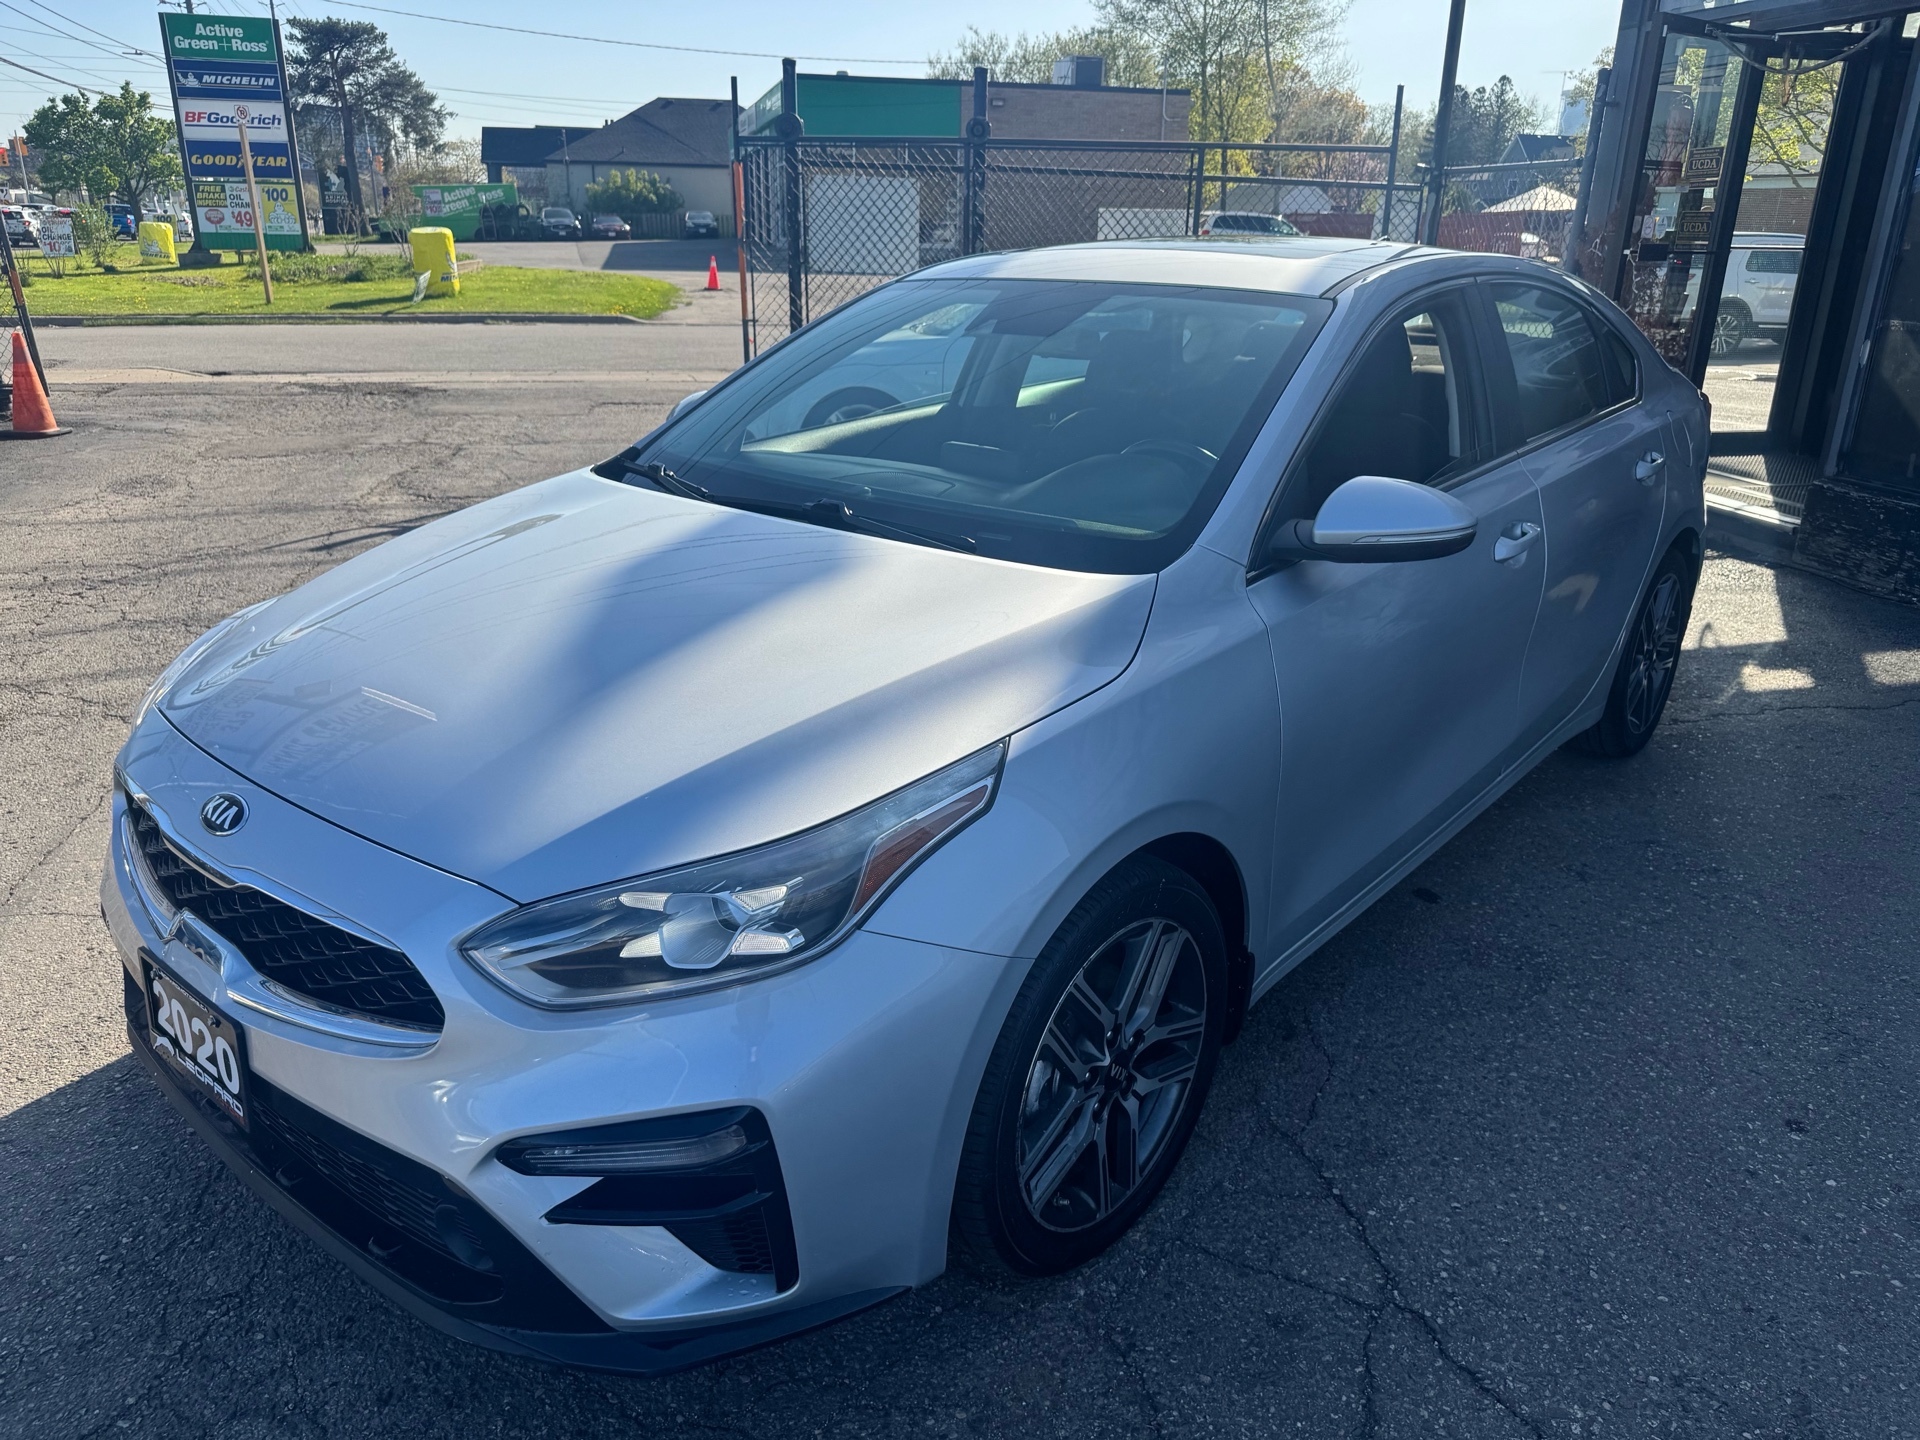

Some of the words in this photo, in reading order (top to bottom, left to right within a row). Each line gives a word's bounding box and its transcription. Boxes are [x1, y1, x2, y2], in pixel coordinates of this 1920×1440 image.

[195, 22, 244, 38] Active
[202, 74, 275, 86] MICHELIN
[184, 111, 281, 126] BFGoorich
[1692, 159, 1717, 170] UCDA
[262, 188, 288, 202] $100
[444, 186, 476, 202] Active
[230, 201, 250, 209] CHAN
[1683, 222, 1708, 232] UCDA
[205, 795, 239, 830] KIA
[152, 979, 240, 1095] 2020
[175, 1051, 244, 1118] LEOPARD
